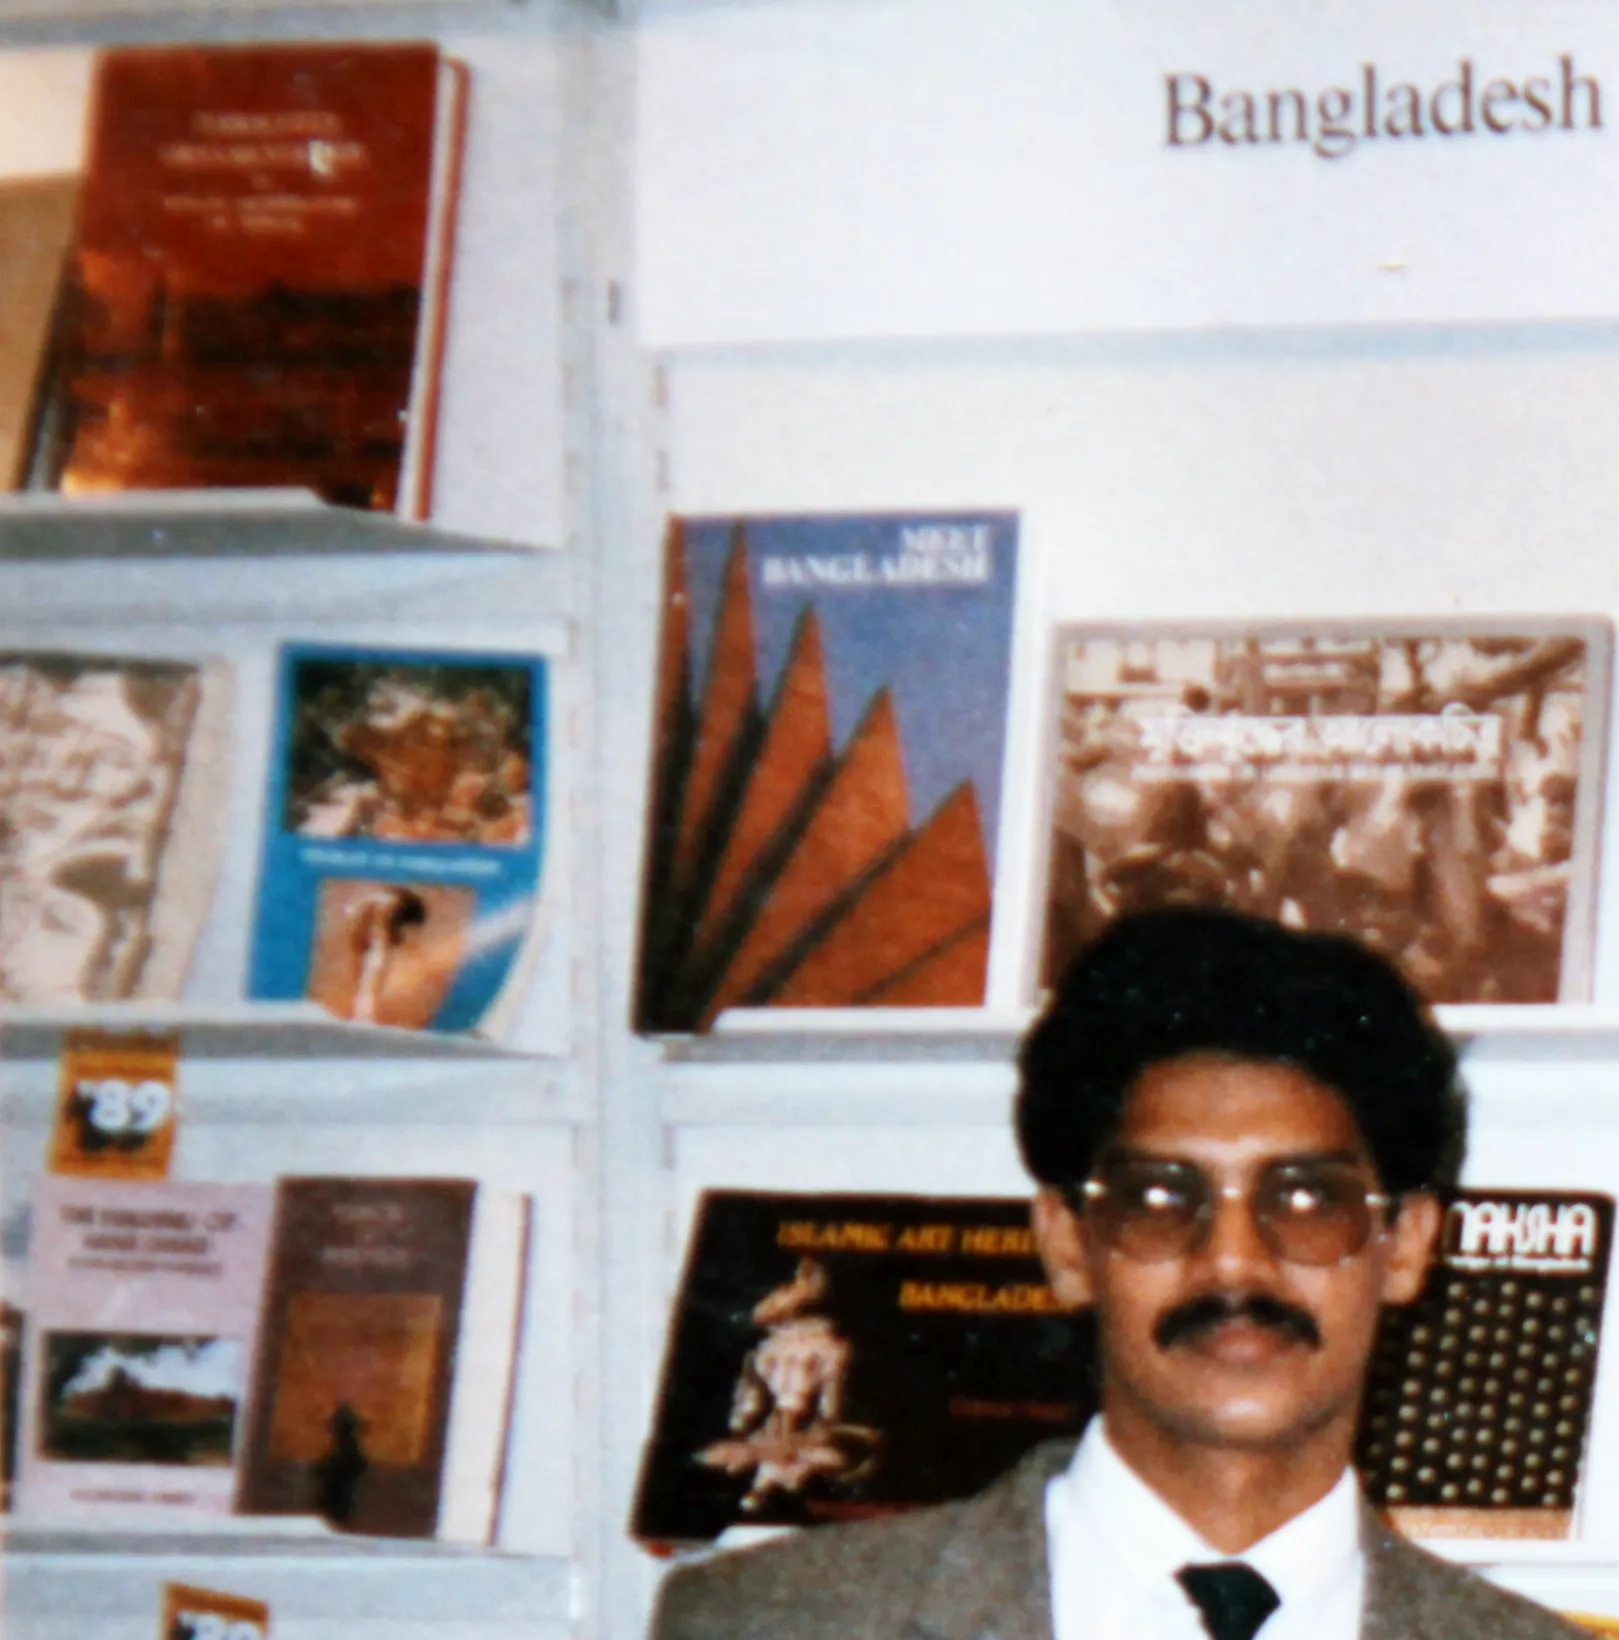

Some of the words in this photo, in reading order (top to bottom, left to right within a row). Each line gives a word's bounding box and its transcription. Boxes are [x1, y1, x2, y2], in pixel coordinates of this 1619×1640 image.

[1162, 55, 1605, 158] Bangladesh
[901, 525, 991, 553] MEET
[761, 552, 990, 588] BANGLADESH
[76, 1078, 172, 1133] '89
[961, 1226, 1038, 1257] HERI
